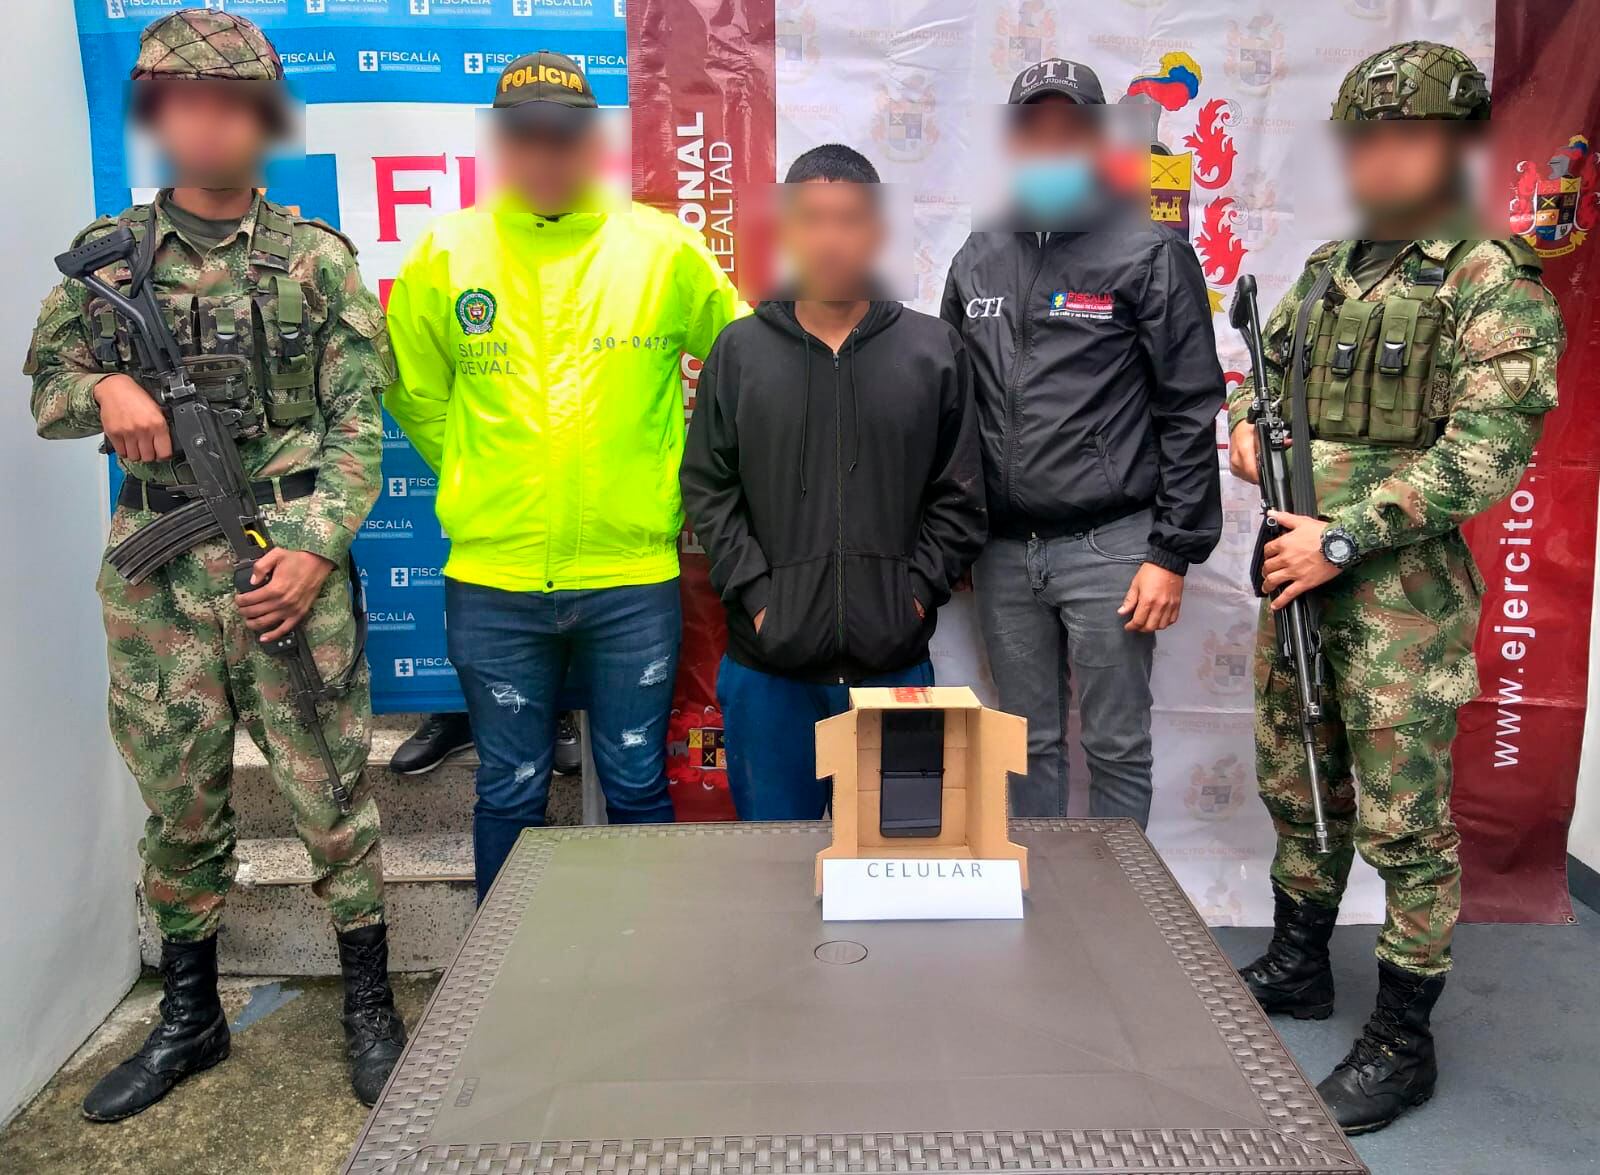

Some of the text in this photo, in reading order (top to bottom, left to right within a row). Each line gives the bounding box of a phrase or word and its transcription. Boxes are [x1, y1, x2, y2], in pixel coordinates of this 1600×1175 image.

[279, 49, 336, 64] FISCALÍA
[380, 50, 440, 62] FISCALÍA
[501, 65, 583, 93] POLICIA
[1021, 60, 1077, 87] CTI
[708, 141, 736, 273] LEALTAD
[966, 296, 1004, 319] CTI
[458, 341, 508, 358] SIJIN
[866, 862, 983, 879] CELULAR
